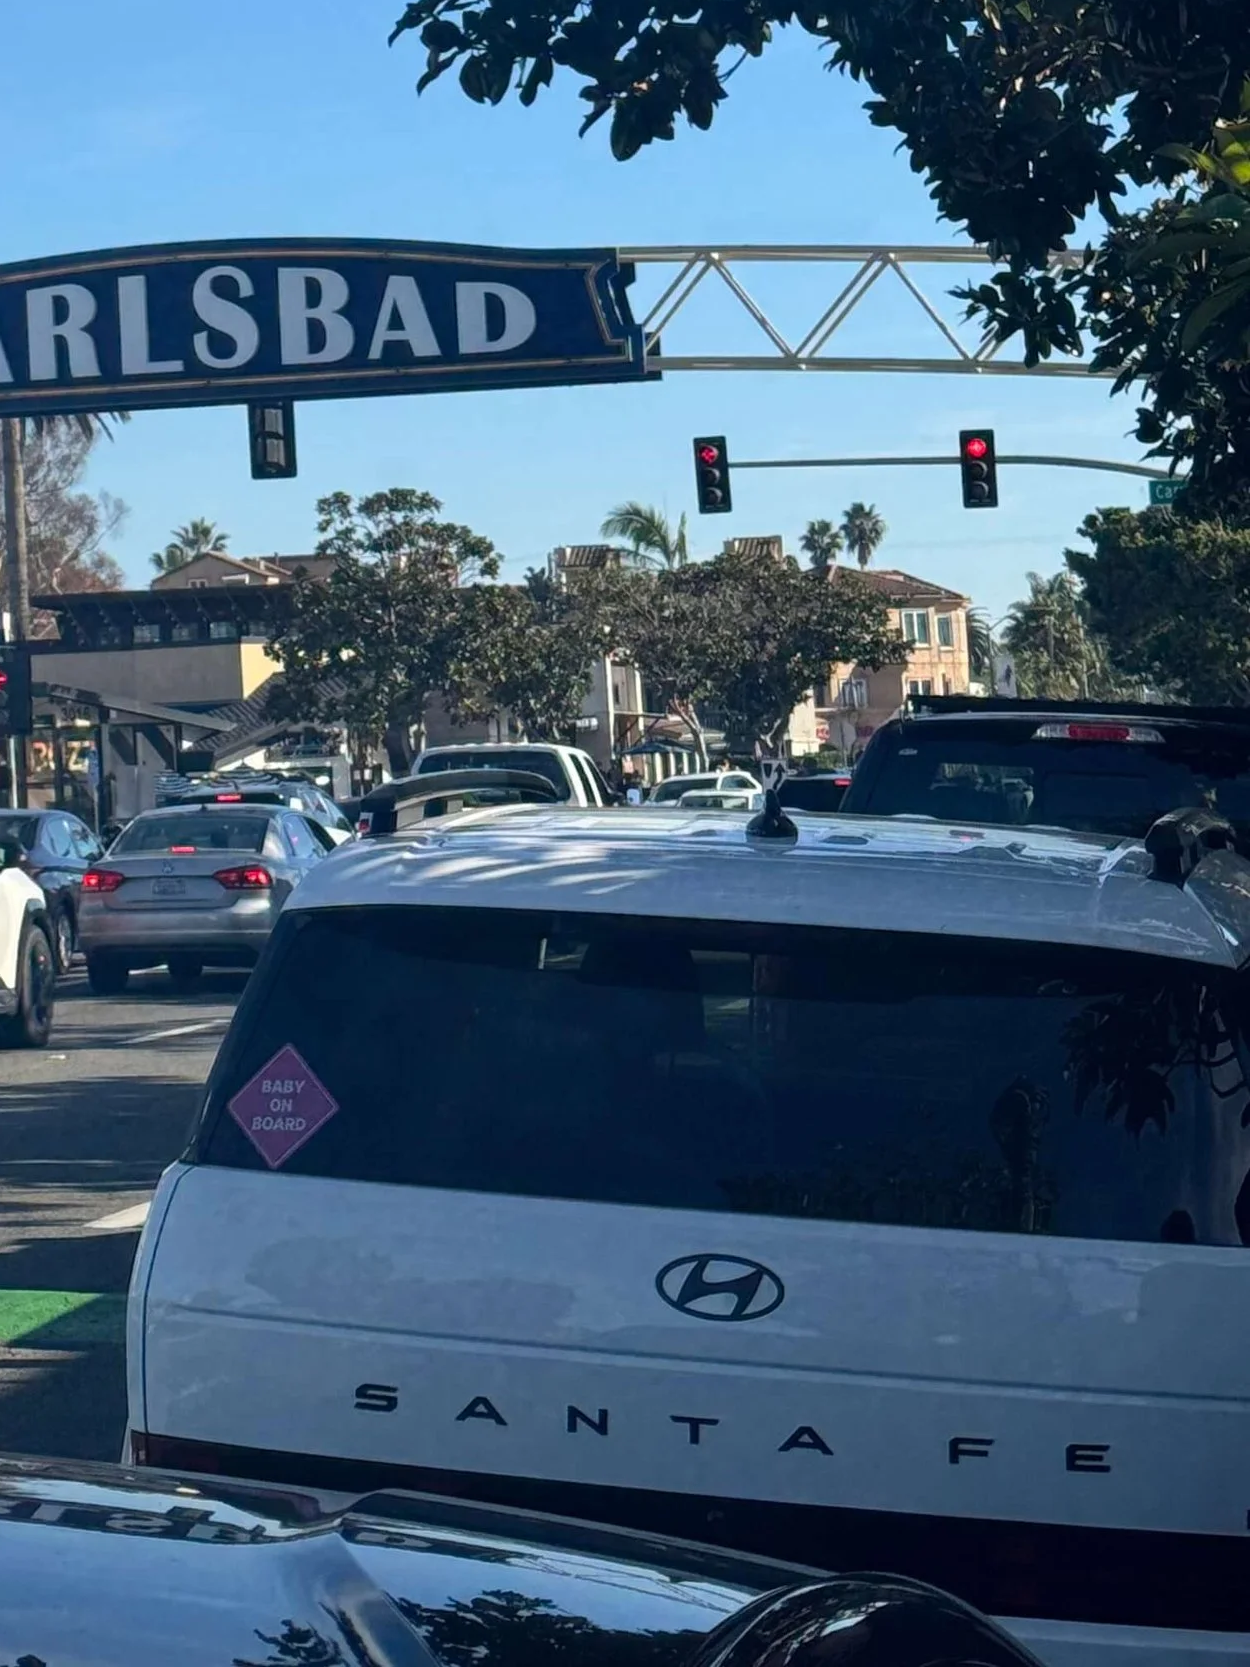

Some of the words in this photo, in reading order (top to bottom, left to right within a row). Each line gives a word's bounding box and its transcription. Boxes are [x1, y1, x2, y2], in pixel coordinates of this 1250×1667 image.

[261, 1080, 307, 1094] BABY
[269, 1098, 293, 1113] ON
[251, 1116, 307, 1132] BOARD
[353, 1382, 834, 1457] SANTA
[948, 1436, 1112, 1473] FE
